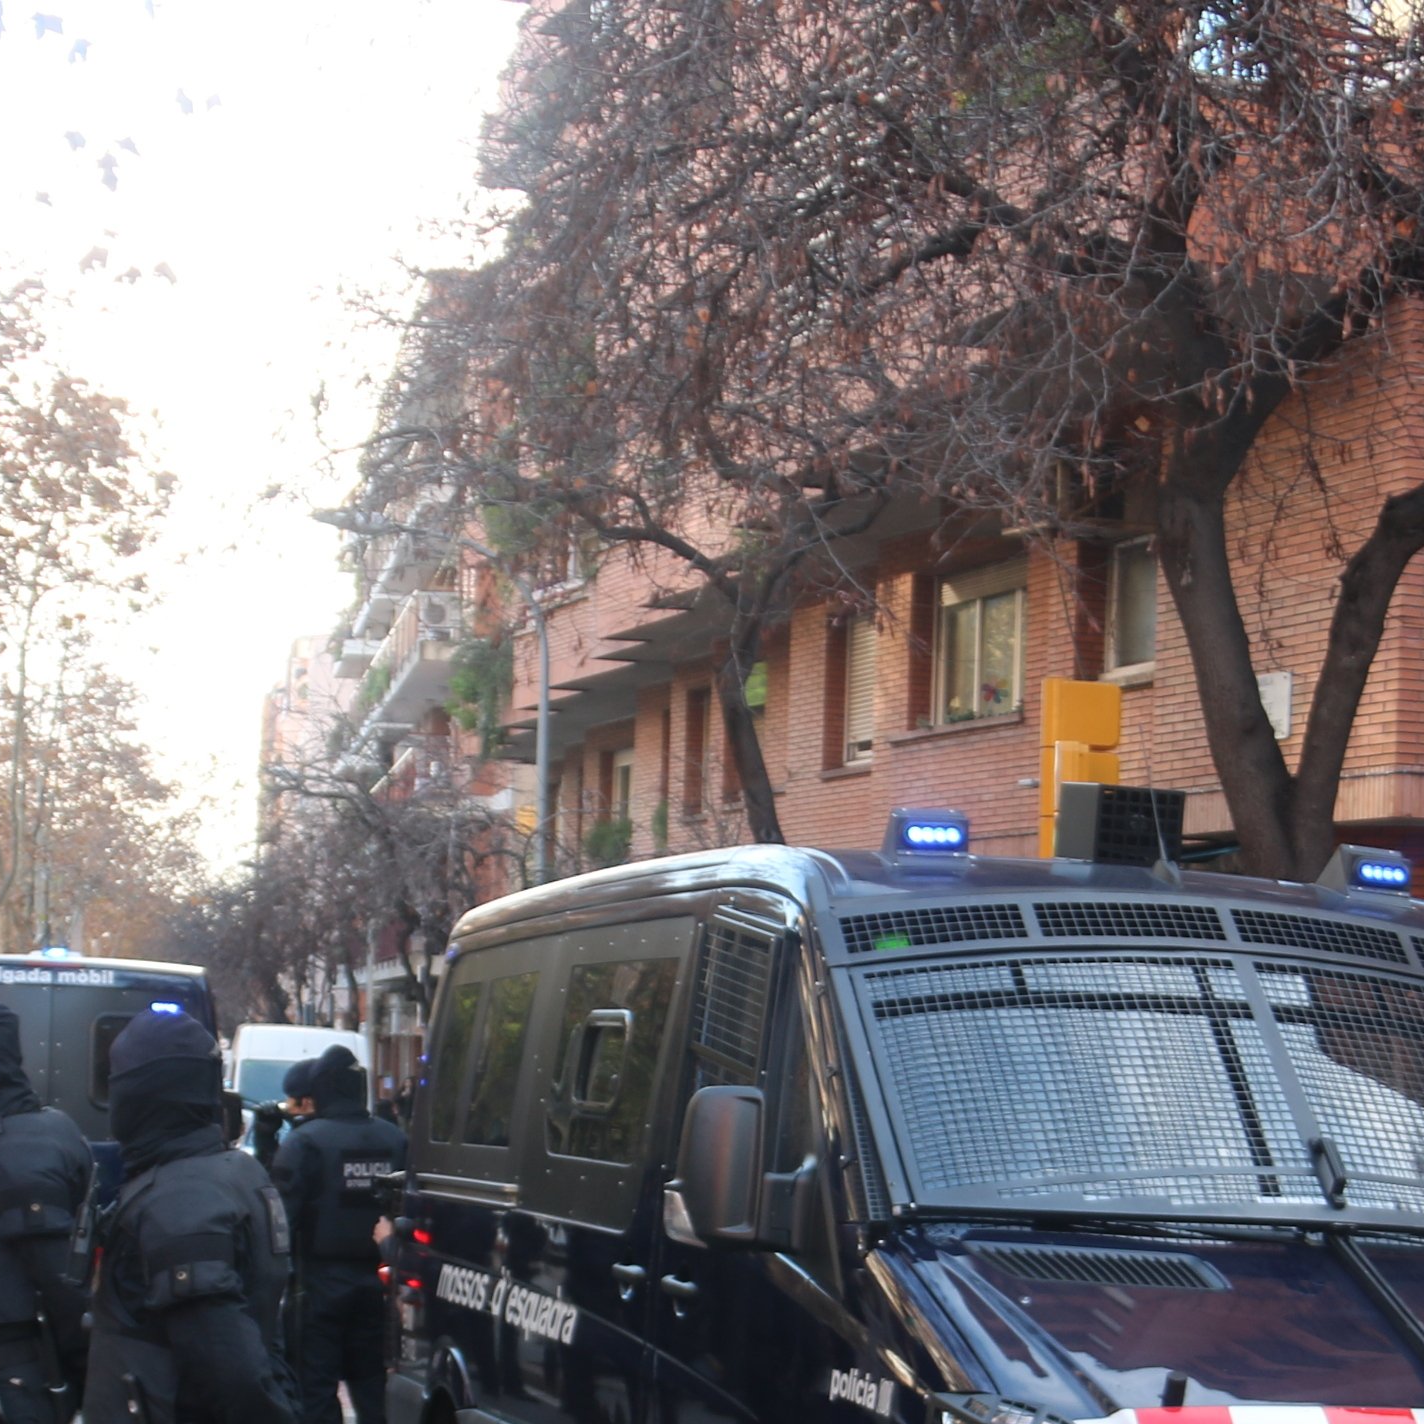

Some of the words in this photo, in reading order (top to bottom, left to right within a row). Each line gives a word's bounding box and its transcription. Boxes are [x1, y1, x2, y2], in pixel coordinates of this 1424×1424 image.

[57, 968, 115, 985] mòbil
[436, 1263, 490, 1311] mossos
[488, 1265, 577, 1345] d'esquadra
[829, 1367, 877, 1411] policia
